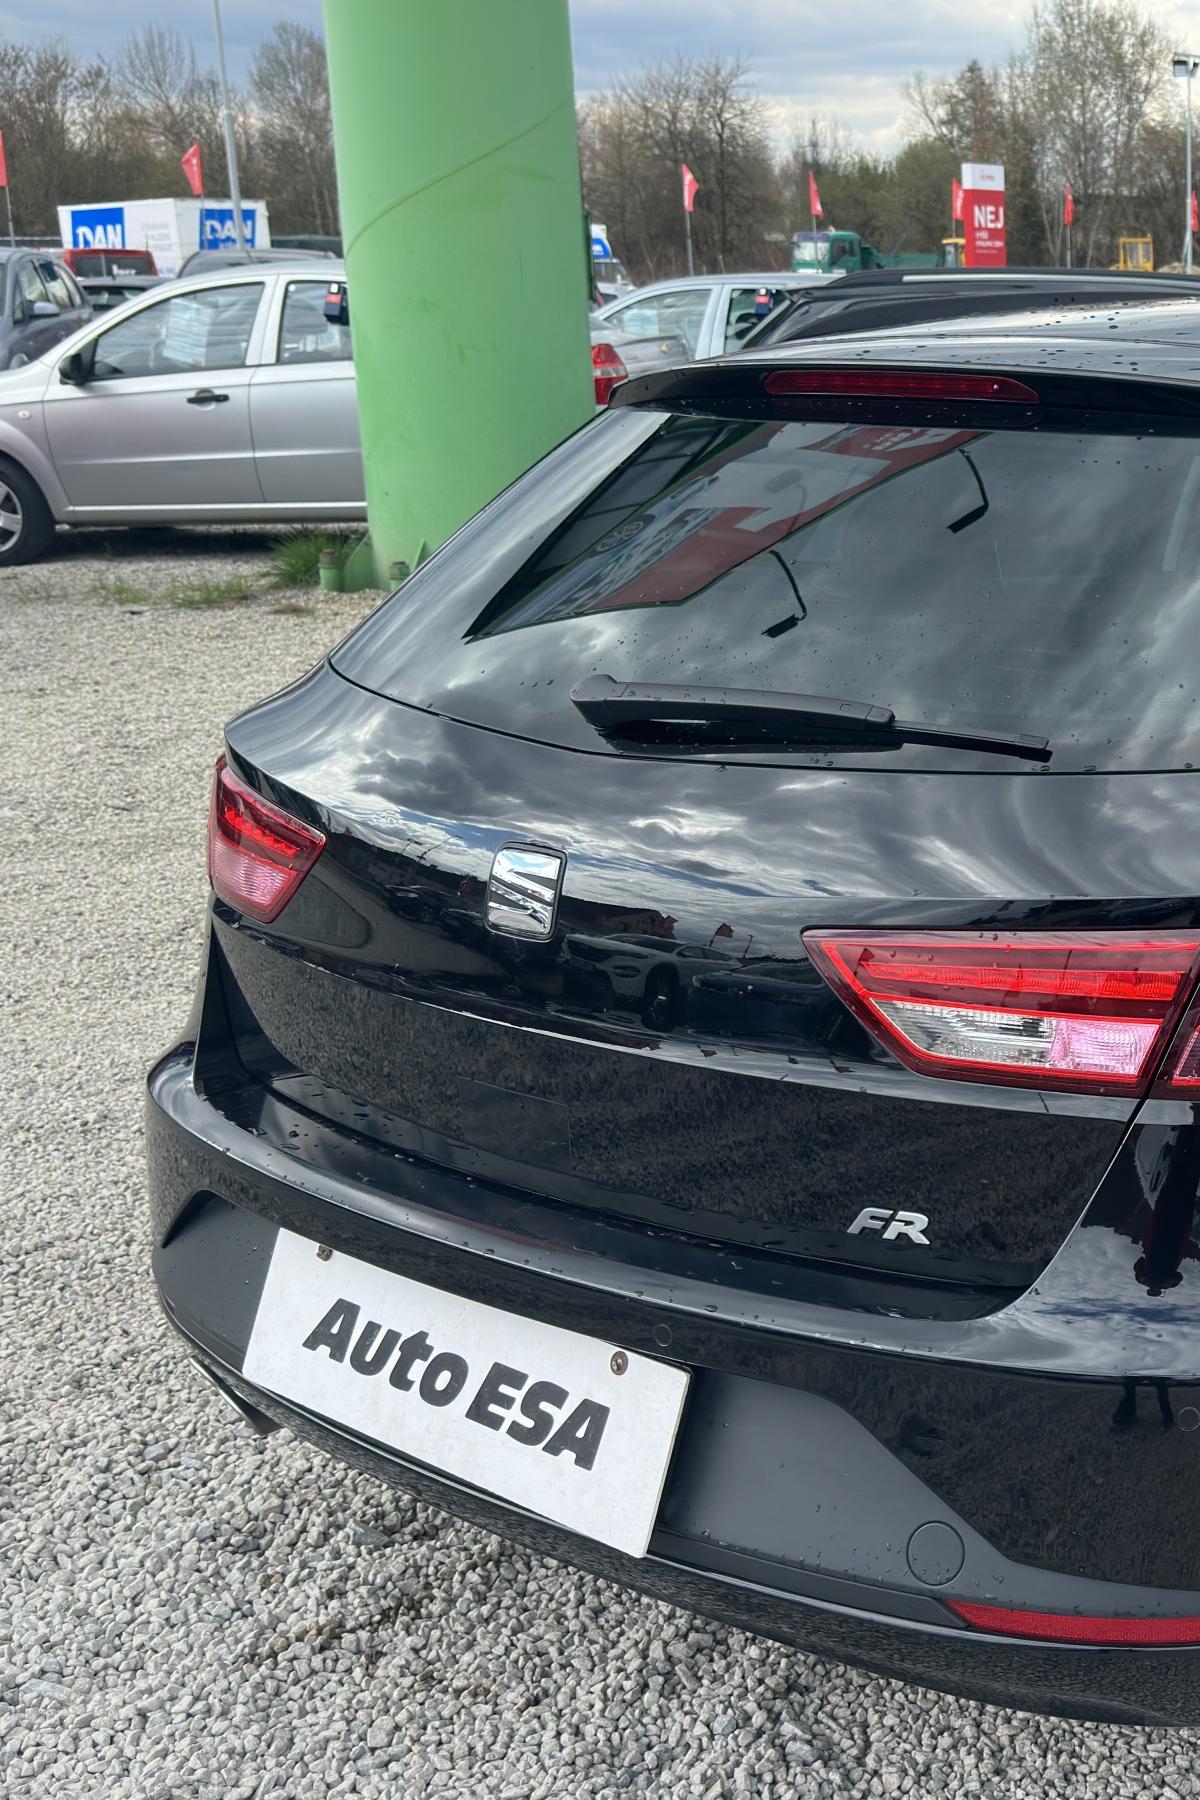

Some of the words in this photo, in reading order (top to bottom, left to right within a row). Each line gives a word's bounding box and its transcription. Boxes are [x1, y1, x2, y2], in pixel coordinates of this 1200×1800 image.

[973, 205, 1004, 229] NEJ
[76, 224, 122, 249] DAN
[847, 1207, 930, 1245] FR
[302, 1297, 469, 1408] Auto
[464, 1361, 611, 1471] ESA
